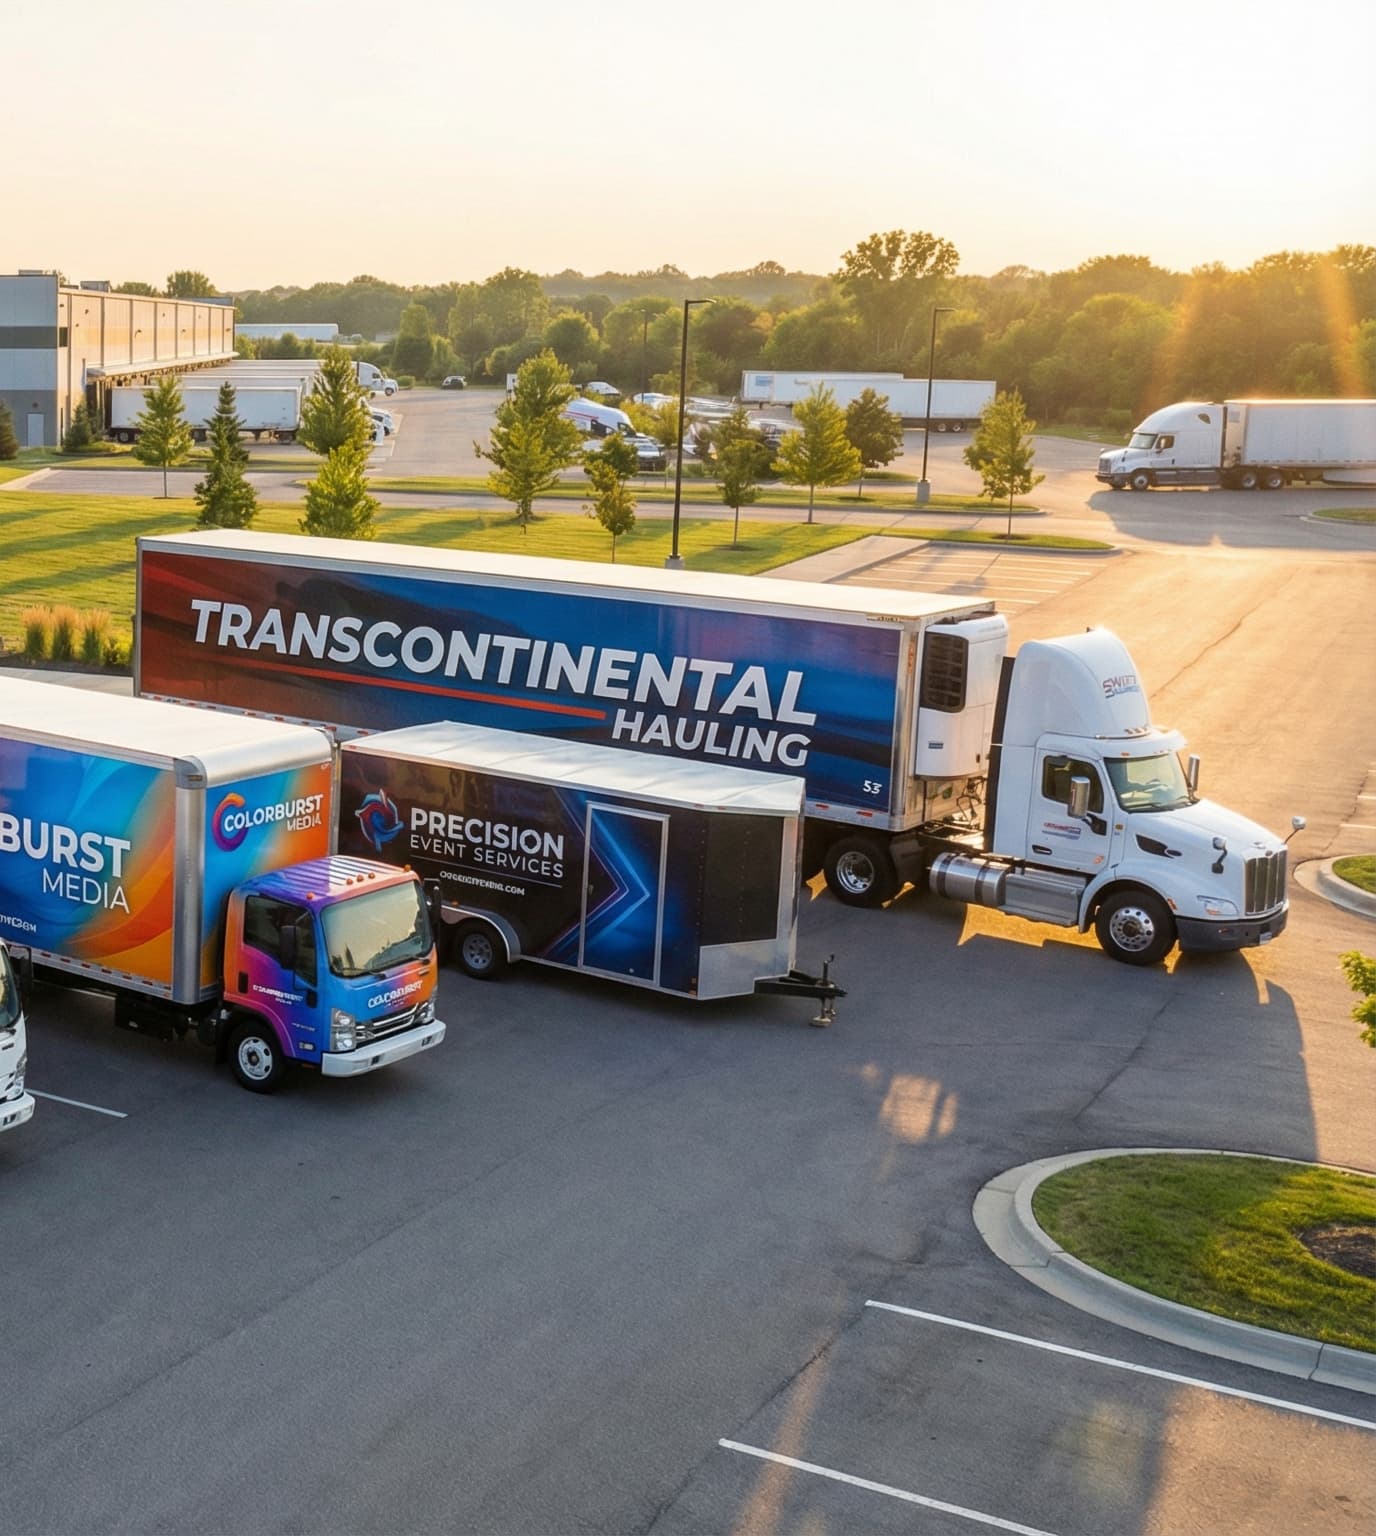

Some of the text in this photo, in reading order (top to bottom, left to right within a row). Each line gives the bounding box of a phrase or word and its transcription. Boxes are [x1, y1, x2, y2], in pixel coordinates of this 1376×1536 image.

[189, 599, 818, 727] TRANSCONTINENTAL
[611, 708, 812, 767] HAULING
[224, 794, 324, 832] COLORBURST
[287, 813, 322, 832] MEDIA
[410, 807, 564, 860] PRECISION
[410, 834, 564, 878] EVENT SERVICES
[42, 867, 130, 914] MEDIA
